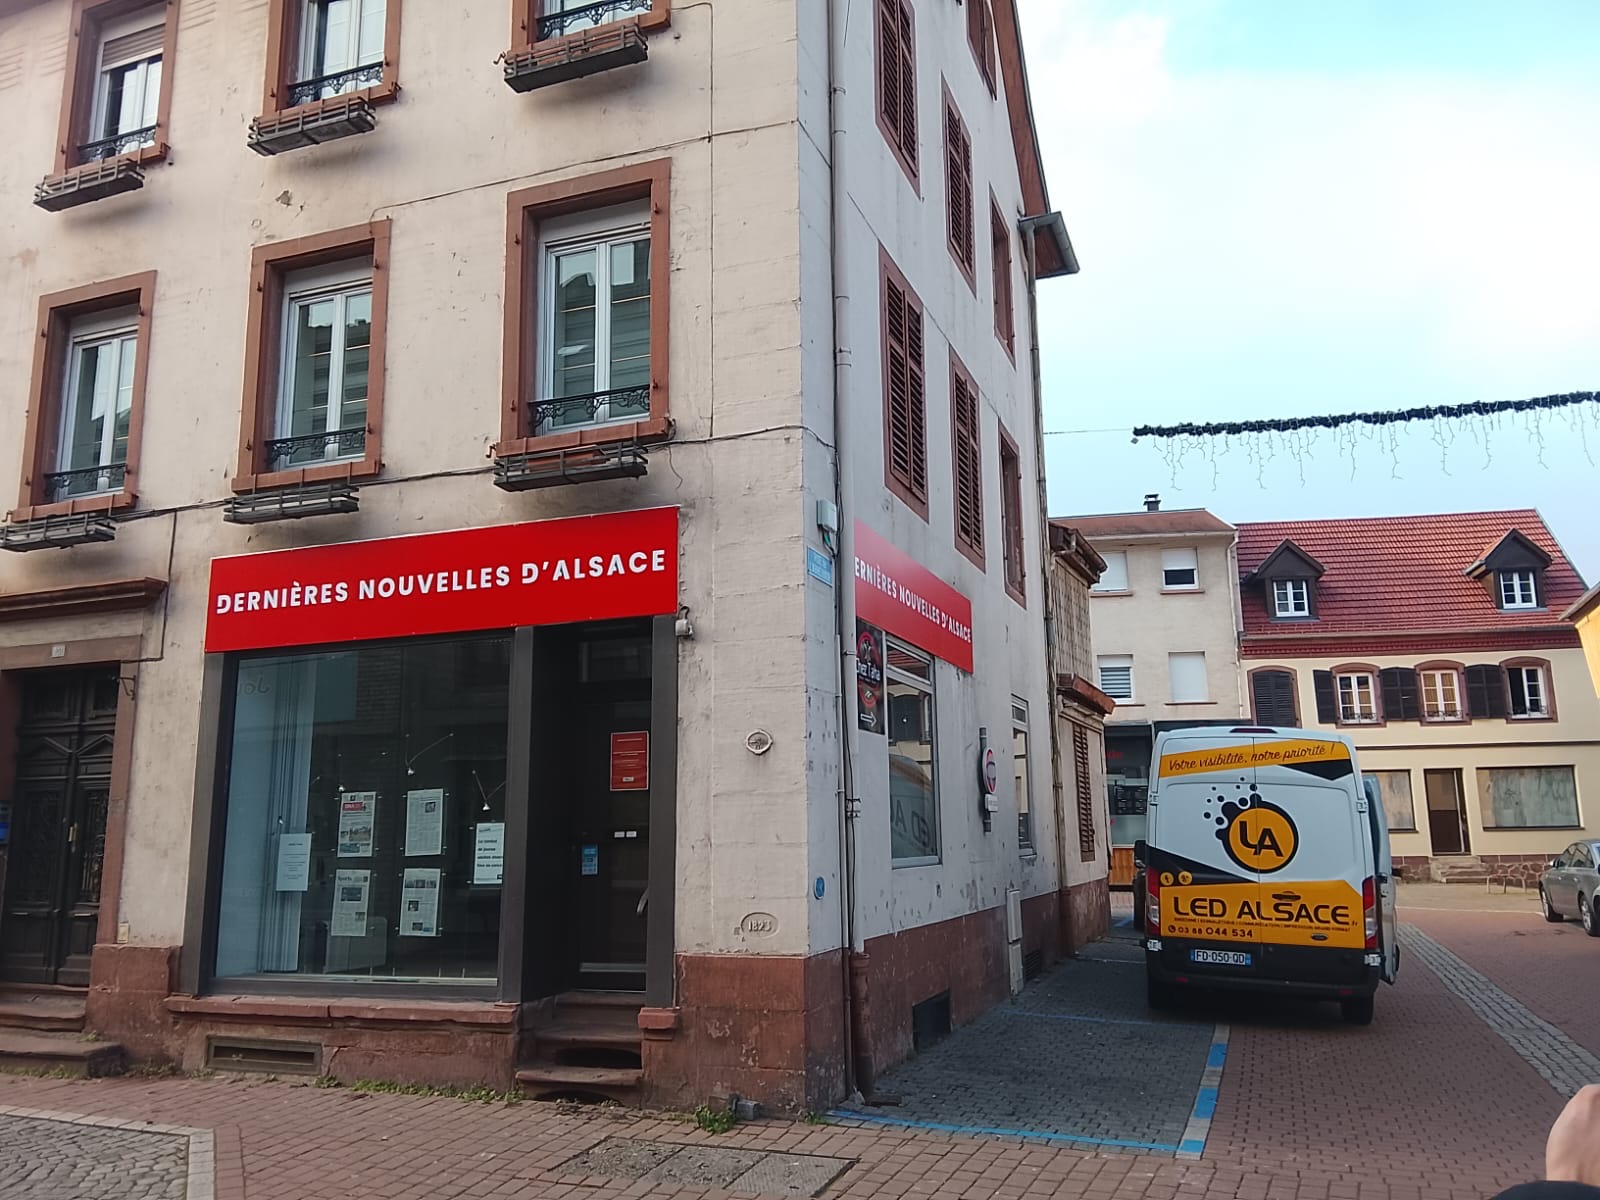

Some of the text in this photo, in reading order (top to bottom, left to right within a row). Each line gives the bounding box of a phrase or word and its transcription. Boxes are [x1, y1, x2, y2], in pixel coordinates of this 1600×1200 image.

[216, 580, 348, 615] DERNIÈRES
[358, 565, 511, 600] NOUVELLES
[854, 556, 897, 599] ERNIÈRES
[899, 585, 940, 625] NOUVELLES
[1169, 759, 1197, 771] Votre
[1199, 752, 1247, 768] visibilité,
[1251, 750, 1281, 762] notre
[1282, 745, 1326, 761] priorité
[1239, 820, 1284, 857] LA
[1173, 896, 1227, 918] LED
[1237, 900, 1350, 925] ALSACE
[1205, 927, 1228, 937] 044
[1231, 928, 1253, 938] 534
